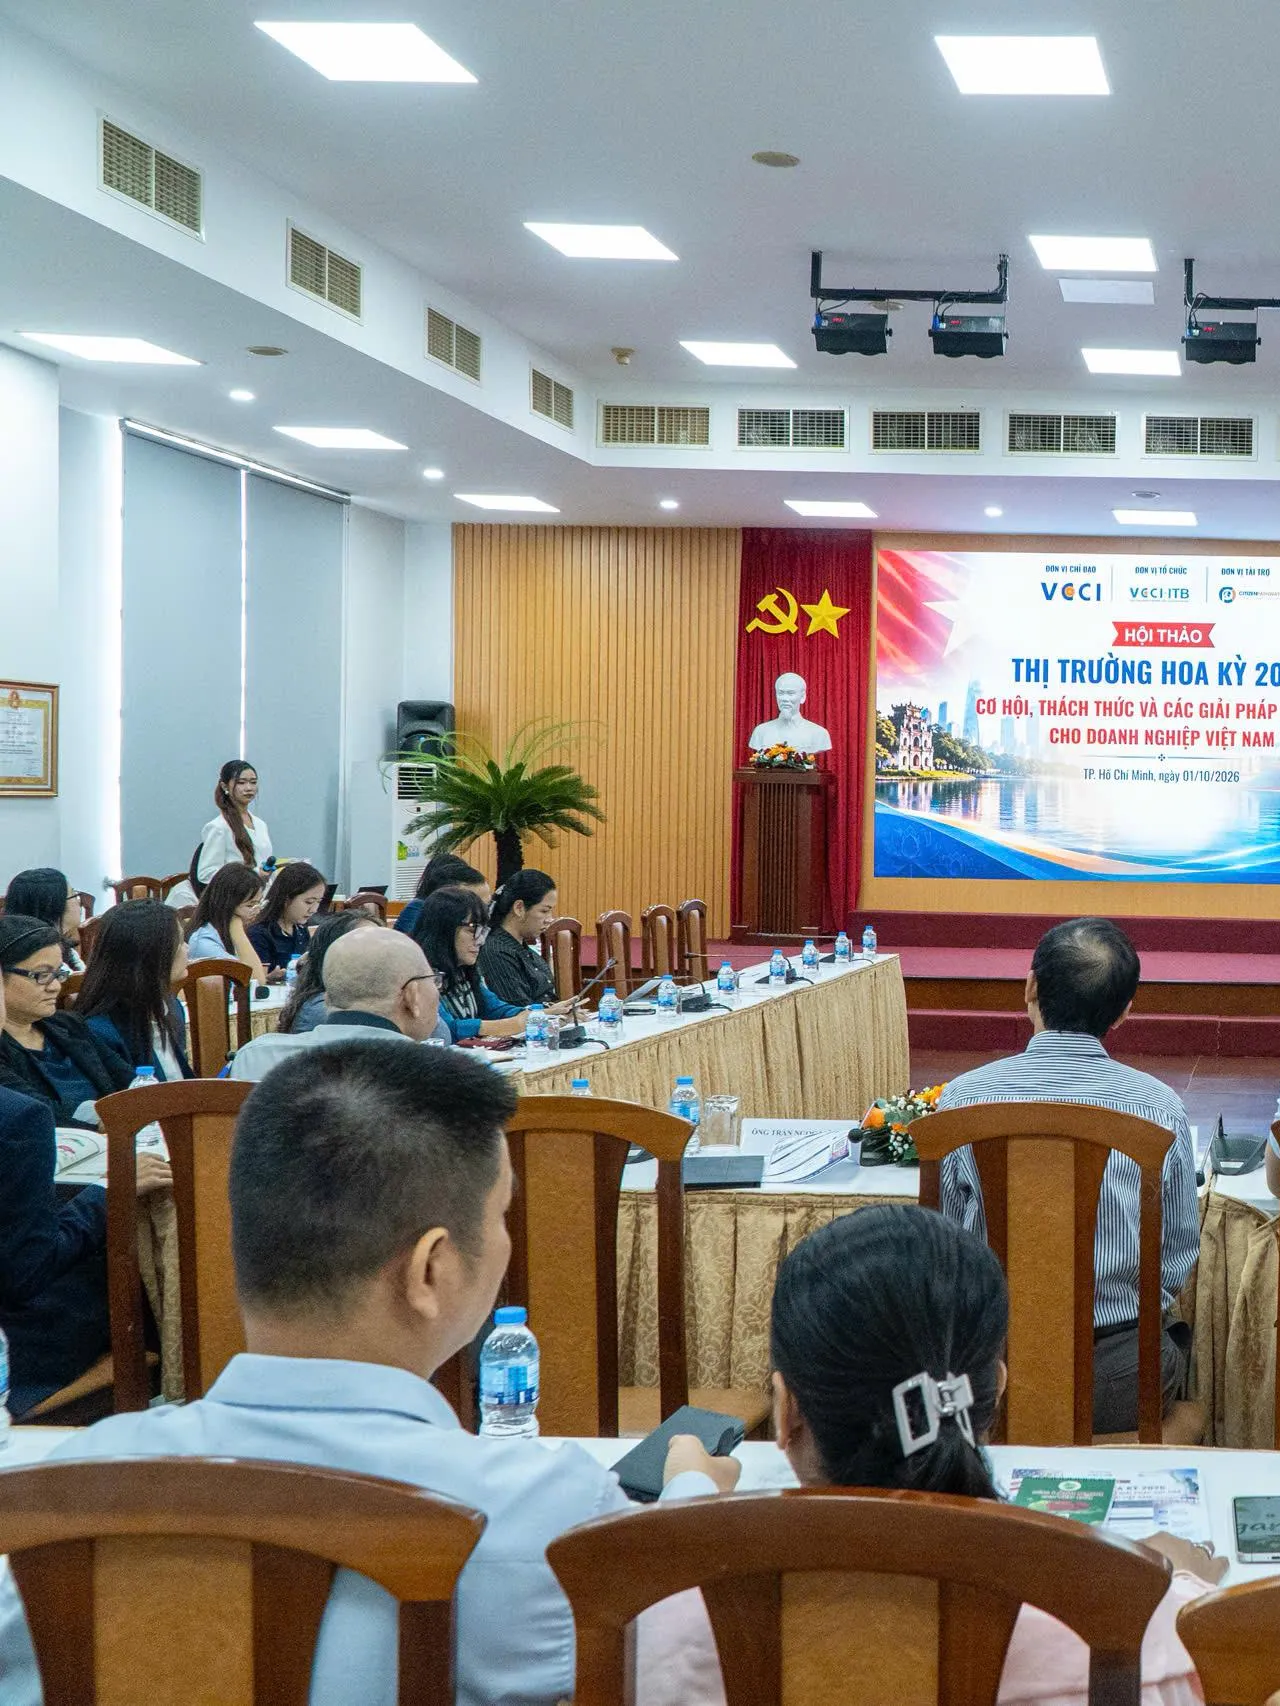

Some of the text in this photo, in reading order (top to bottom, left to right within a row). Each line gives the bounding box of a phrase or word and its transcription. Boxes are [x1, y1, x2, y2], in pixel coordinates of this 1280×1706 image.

[1041, 582, 1102, 602] VCCI
[1124, 625, 1203, 646] HỘI THẢO
[1011, 658, 1049, 689] THỊ
[1057, 652, 1152, 685] TRƯỜNG
[1161, 660, 1209, 686] HOA
[1218, 654, 1247, 686] KỲ
[976, 697, 998, 715] CƠ
[1002, 695, 1034, 719] HỘI,
[1038, 696, 1089, 717] THÁCH
[1095, 696, 1135, 717] THỨC
[1140, 697, 1158, 718] VÀ
[1163, 697, 1194, 718] CÁC
[1198, 698, 1230, 719] GIẢI
[1235, 699, 1278, 720] PHÁP
[1050, 726, 1275, 750] CHO DOANH NGHIỆP VIỆT NAM
[1083, 768, 1240, 784] TP. Hồ Chí Minh, ngày 01/10/2026
